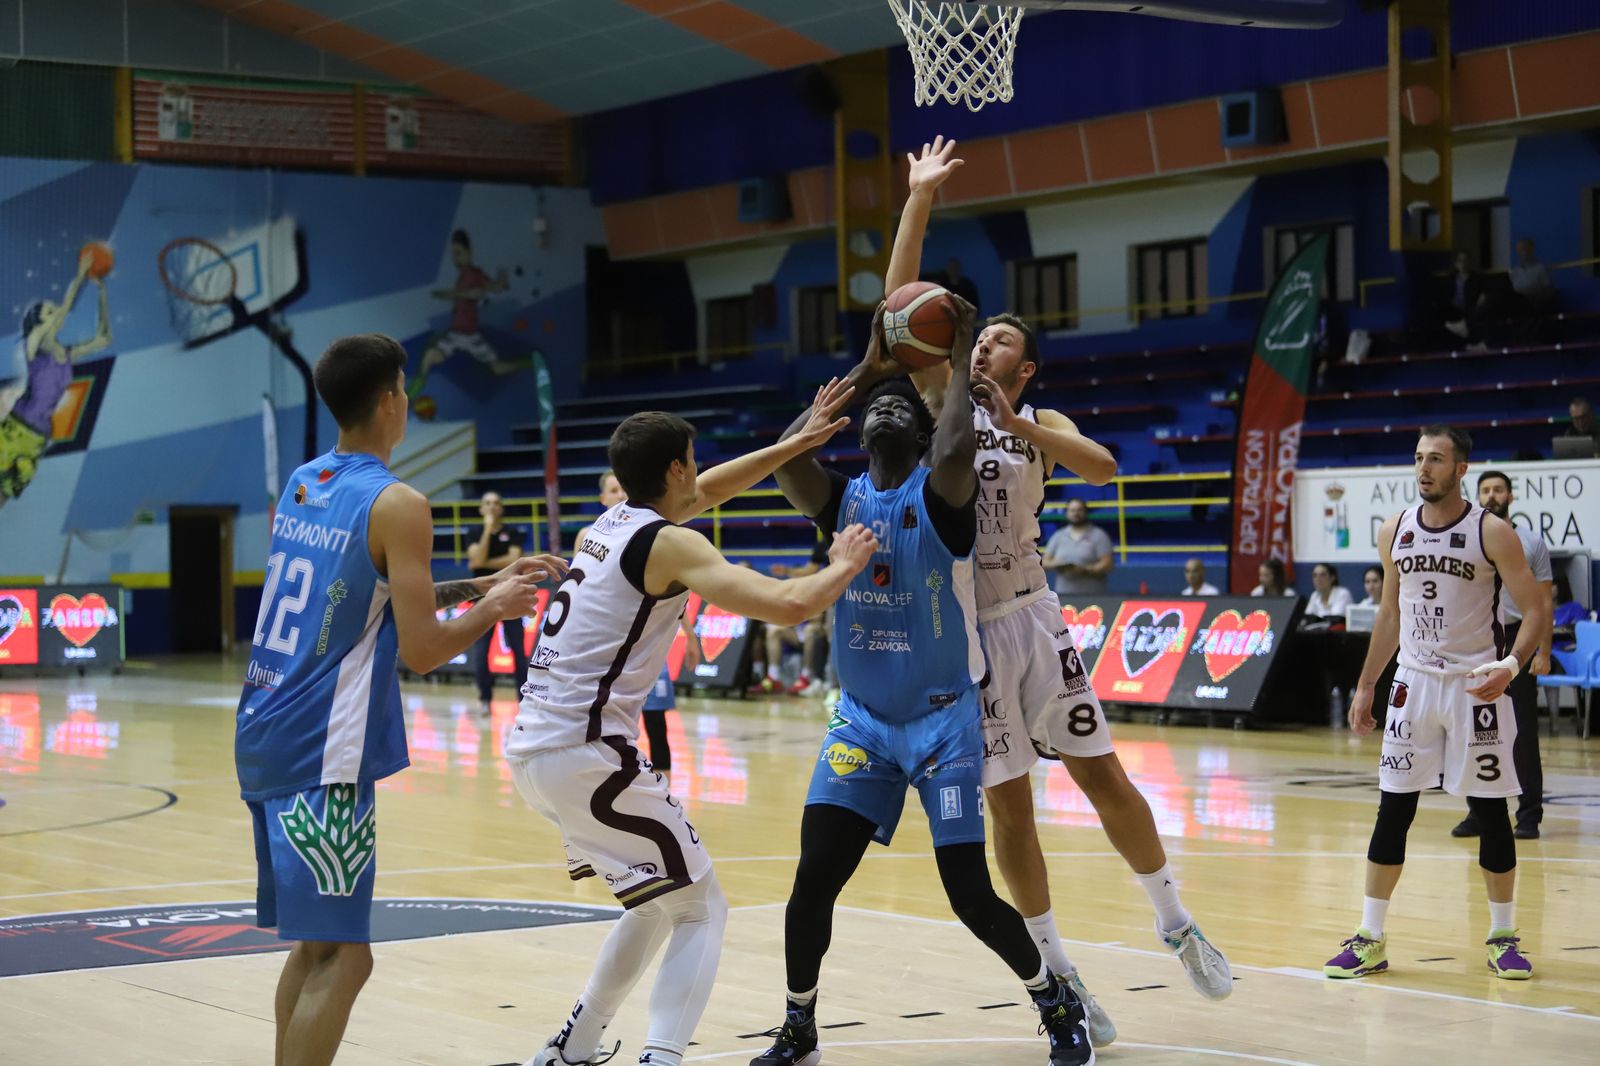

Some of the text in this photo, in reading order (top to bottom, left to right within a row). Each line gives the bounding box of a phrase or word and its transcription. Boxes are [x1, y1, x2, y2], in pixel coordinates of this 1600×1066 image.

[976, 429, 1036, 463] RMES
[979, 460, 1000, 481] 8
[977, 519, 1006, 535] UA
[579, 538, 610, 563] ORALES
[543, 567, 587, 637] 6
[1422, 581, 1438, 600] 3
[252, 551, 315, 657] 12
[1413, 603, 1428, 616] LA
[868, 640, 912, 652] ZAMORA
[1067, 703, 1098, 737] 8
[820, 749, 872, 773] ZAMORA
[1475, 754, 1502, 782] 3
